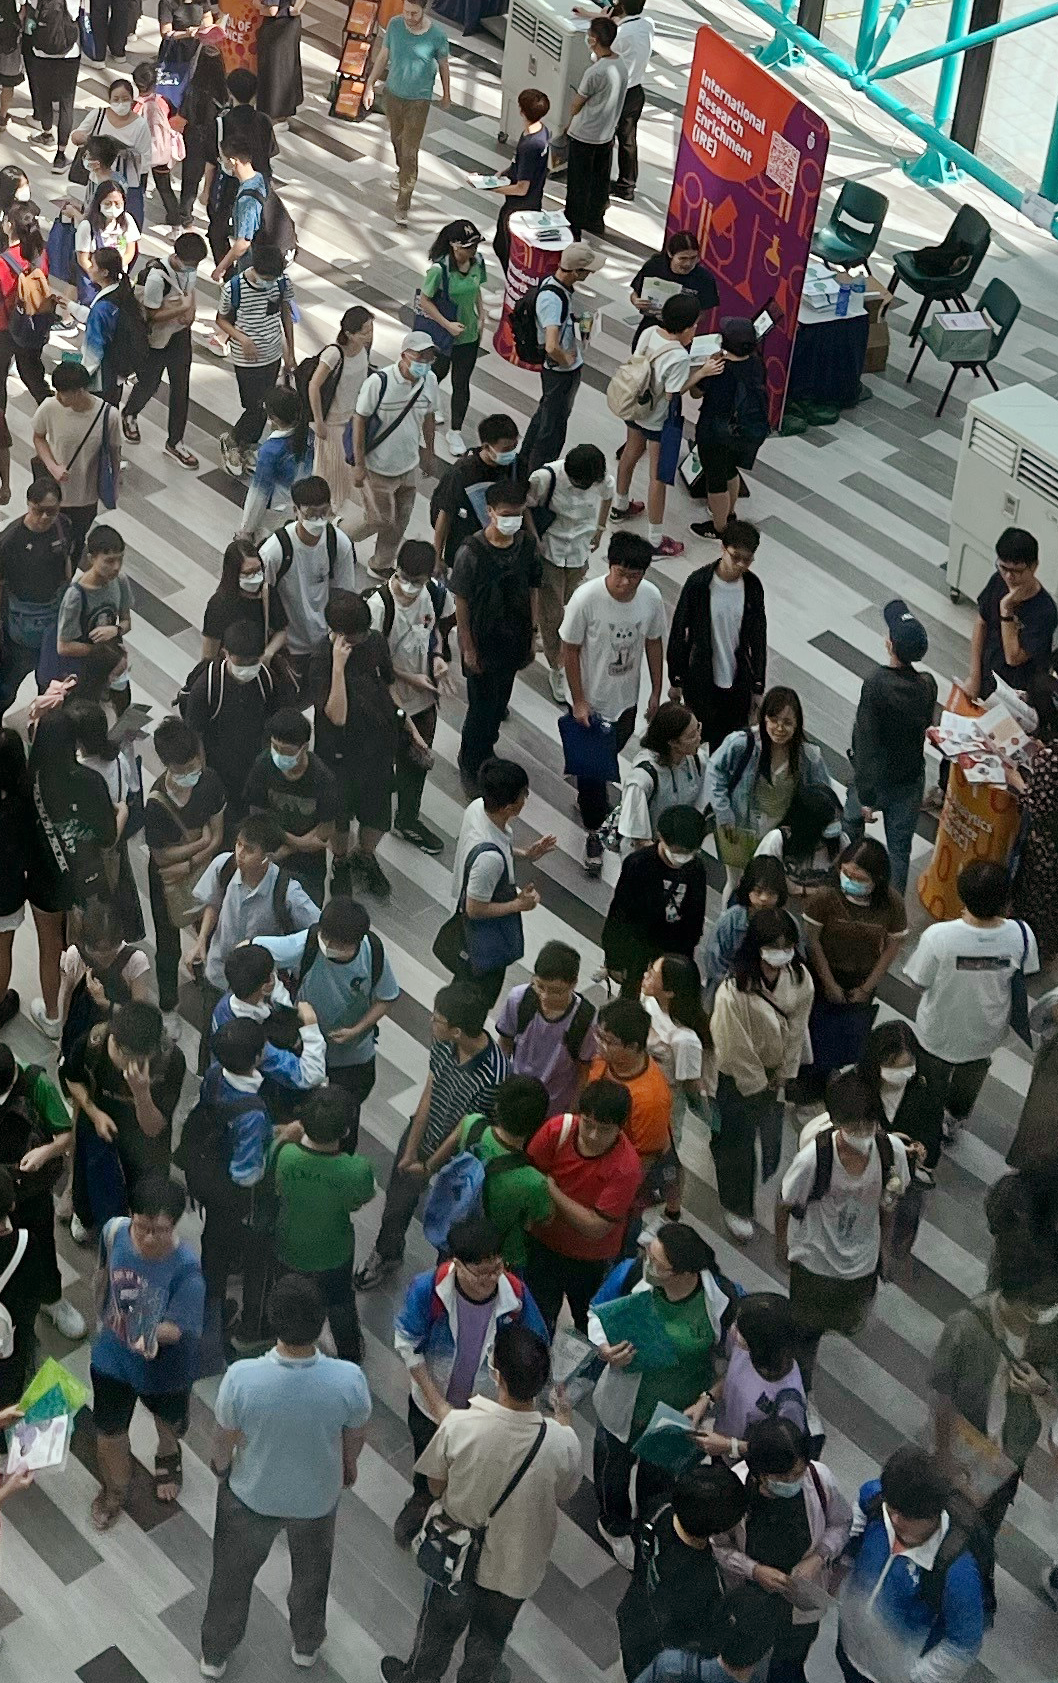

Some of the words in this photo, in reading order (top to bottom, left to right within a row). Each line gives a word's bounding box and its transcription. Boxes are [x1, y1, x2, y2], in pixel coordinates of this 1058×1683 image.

[238, 21, 251, 32] OF
[698, 88, 744, 137] Research
[701, 69, 766, 135] International
[692, 124, 718, 158] (IRE)
[695, 105, 752, 166] Enrichment
